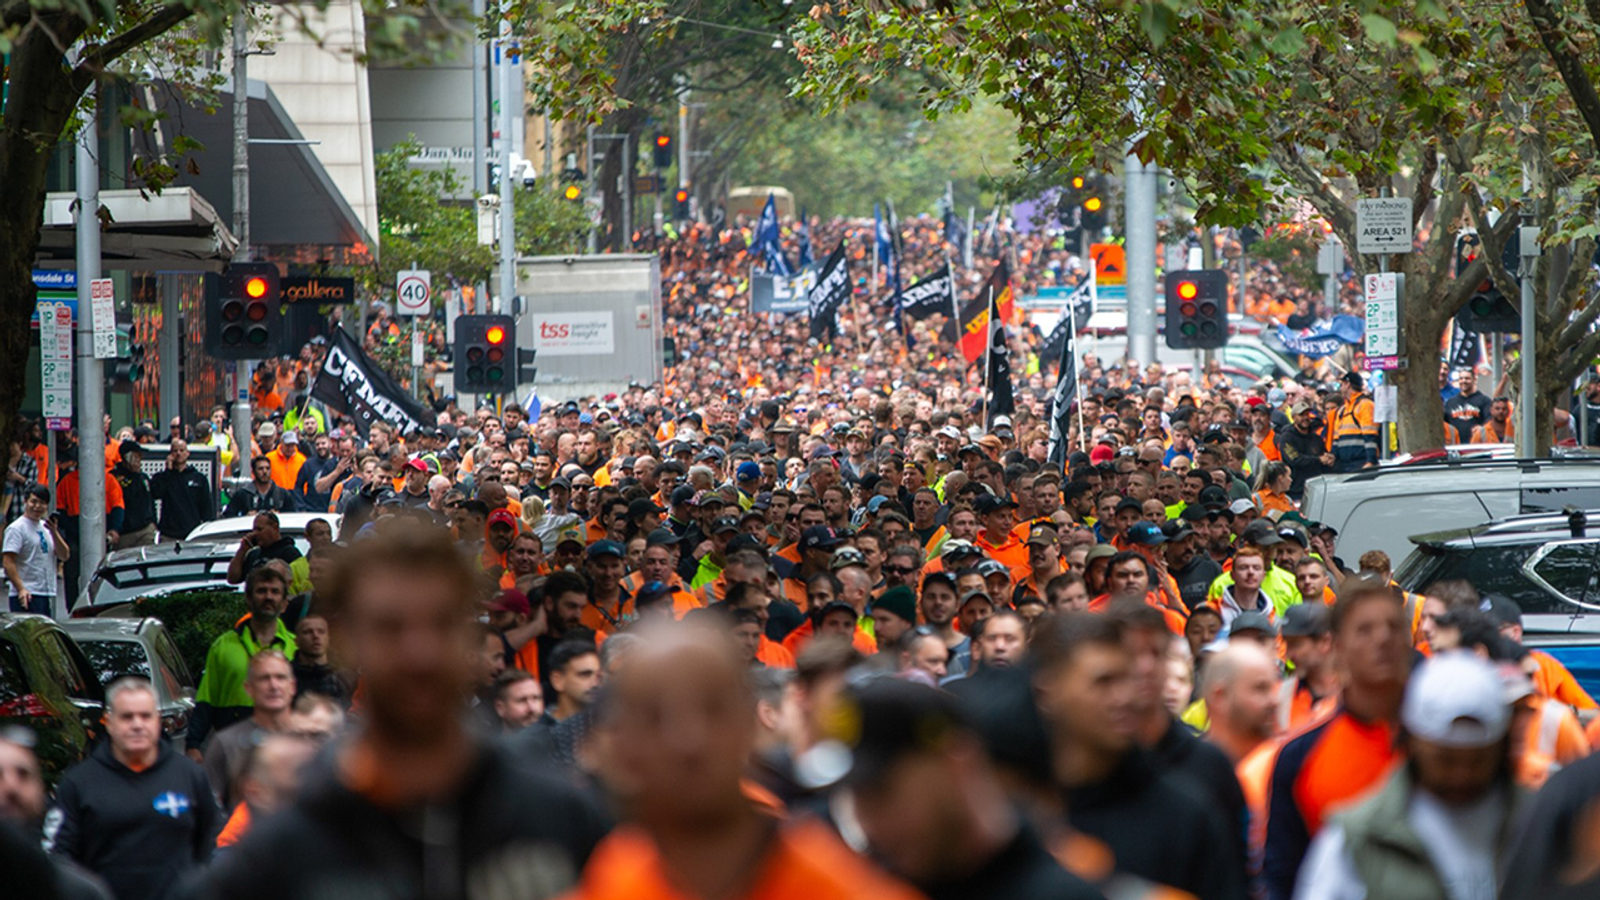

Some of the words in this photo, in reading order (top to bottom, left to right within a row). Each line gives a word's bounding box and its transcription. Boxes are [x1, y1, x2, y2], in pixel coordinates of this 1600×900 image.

[1391, 227, 1406, 235] 521
[64, 273, 75, 283] St
[403, 284, 426, 300] 40
[1367, 303, 1380, 317] 2P
[539, 321, 569, 339] tss
[43, 363, 56, 377] 2P
